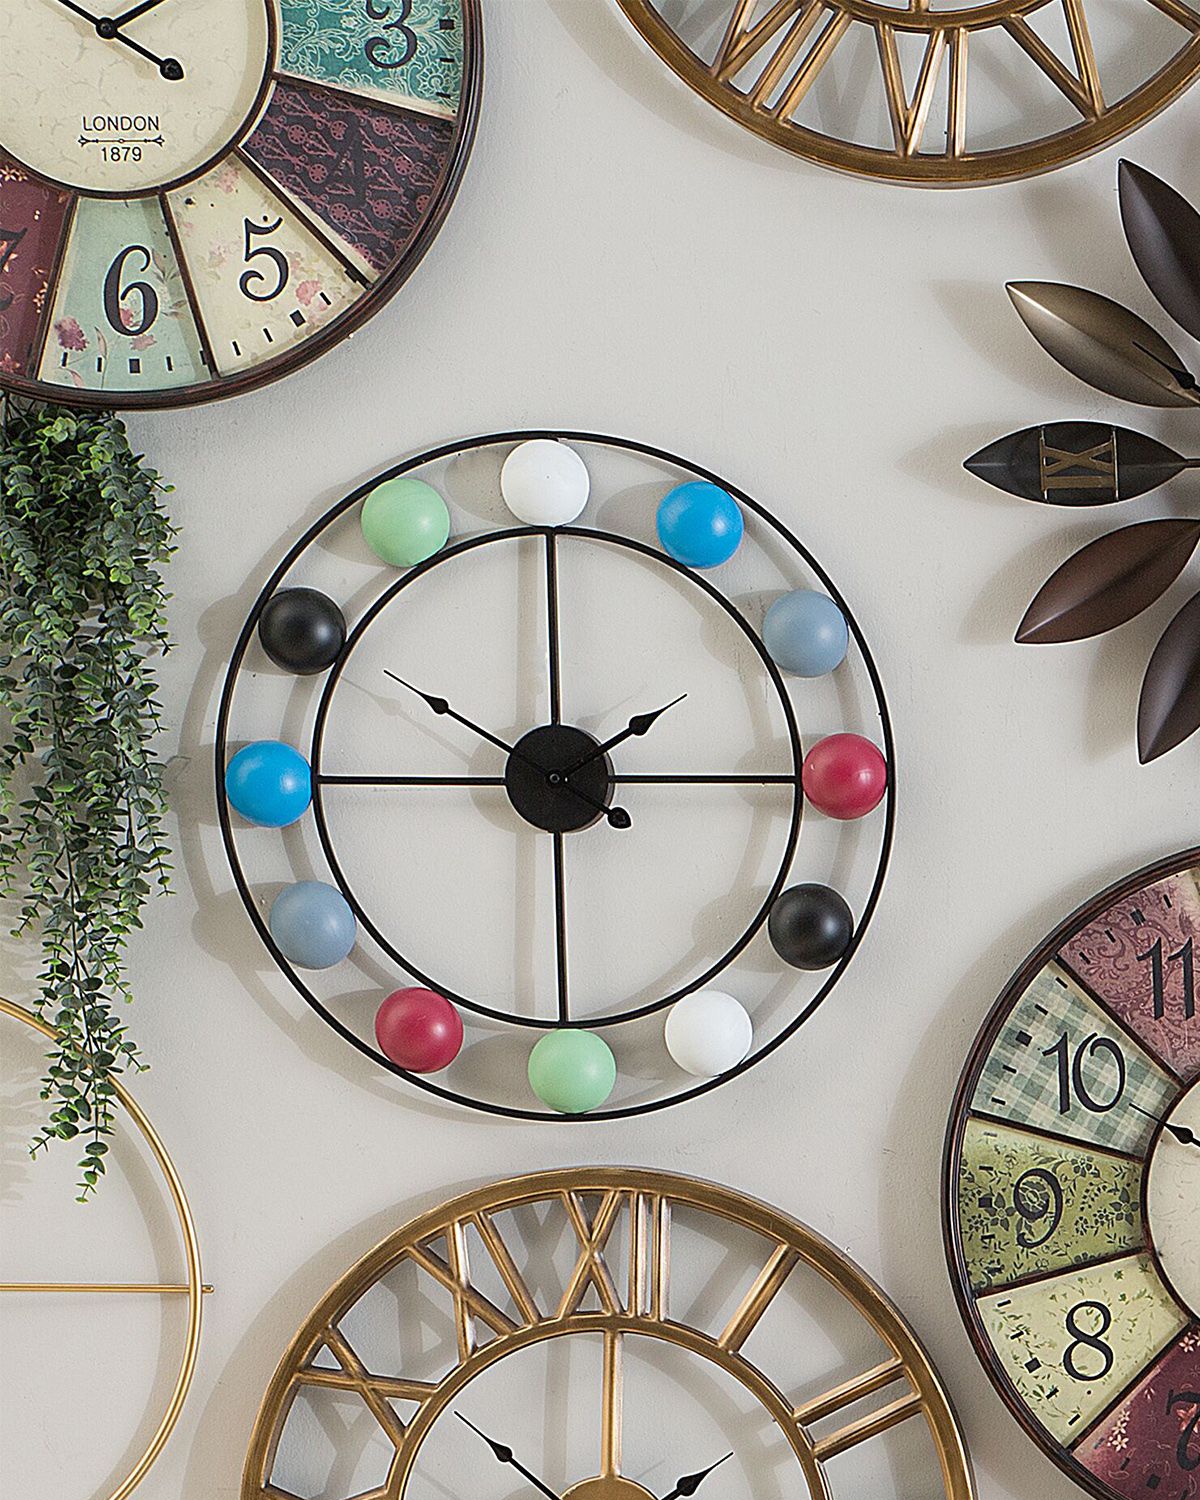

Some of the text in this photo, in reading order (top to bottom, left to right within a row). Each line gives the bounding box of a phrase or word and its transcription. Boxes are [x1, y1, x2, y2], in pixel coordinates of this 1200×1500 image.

[364, 0, 418, 69] 3
[82, 115, 160, 132] LONDON
[876, 20, 969, 159] VI
[100, 145, 143, 162] 1879
[102, 244, 160, 337] 6
[238, 216, 290, 302] 5
[1039, 426, 1119, 500] IX
[1135, 936, 1198, 1021] 11
[1041, 1030, 1126, 1114] 10
[1012, 1167, 1065, 1248] 9
[407, 1209, 541, 1364] XI
[557, 1189, 671, 1322] XII
[720, 1243, 798, 1355] I
[1062, 1300, 1115, 1382] 8
[293, 1325, 442, 1447] X
[793, 1357, 923, 1462] II
